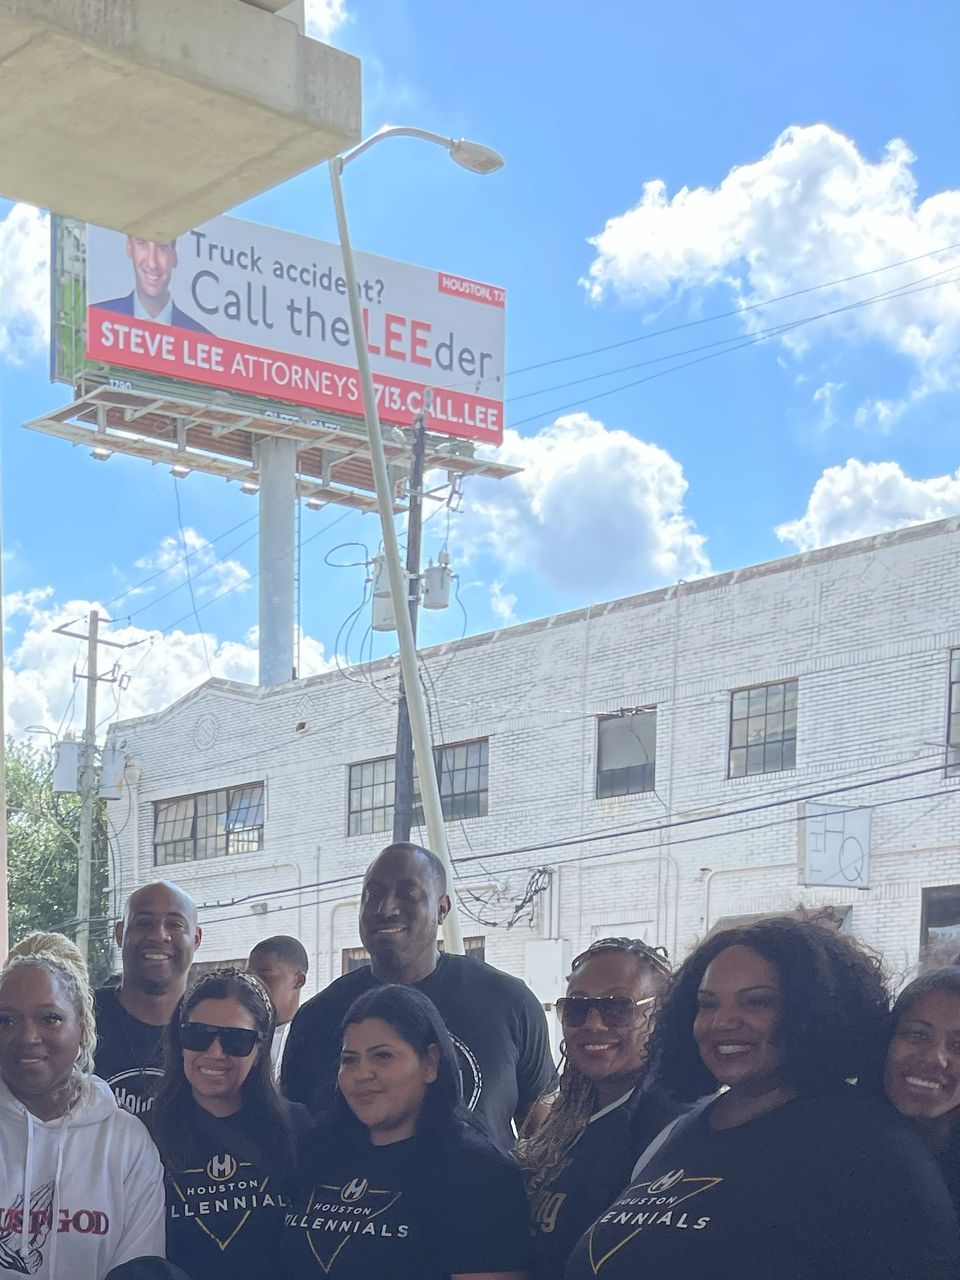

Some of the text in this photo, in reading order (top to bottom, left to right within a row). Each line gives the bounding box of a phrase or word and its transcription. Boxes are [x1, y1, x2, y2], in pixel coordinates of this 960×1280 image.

[190, 231, 385, 305] Truck accidet?
[442, 276, 492, 301] HOUSTON,
[191, 270, 274, 330] Call
[100, 321, 176, 361] STEVE
[183, 340, 225, 374] LEE
[230, 352, 359, 402] ATTORNEYS
[186, 1179, 259, 1196] HOUSTON
[313, 1202, 373, 1216] HOUSTON
